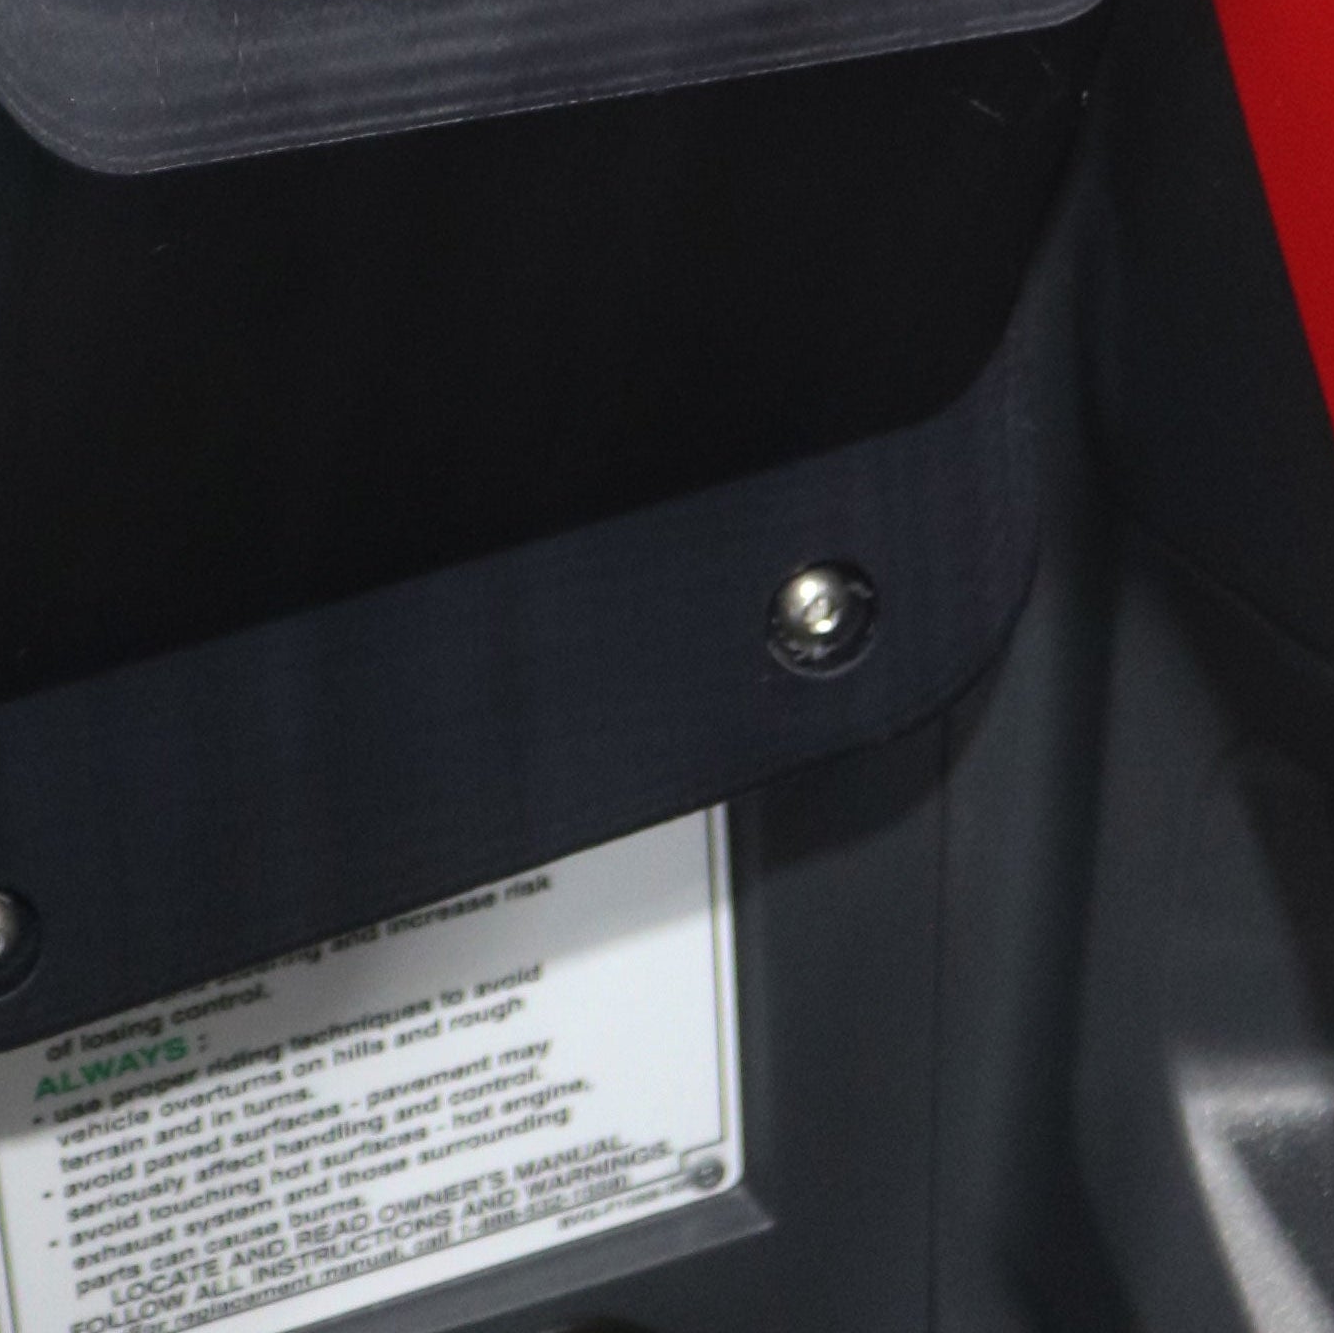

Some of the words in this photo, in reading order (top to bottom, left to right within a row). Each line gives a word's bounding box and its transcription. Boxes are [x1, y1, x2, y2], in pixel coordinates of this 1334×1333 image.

[385, 892, 497, 935] increase
[504, 876, 549, 902] risk
[34, 1036, 189, 1100] ALWAYS
[46, 1038, 73, 1061] of
[81, 1017, 162, 1050] losing
[170, 983, 269, 1024] control.
[54, 1098, 102, 1123] use
[111, 1069, 198, 1108] proper
[206, 1044, 282, 1076] riding
[289, 998, 433, 1048] techniques
[440, 988, 464, 1007] to
[472, 963, 542, 999] avoid
[57, 1110, 150, 1146] vehicle
[160, 1070, 284, 1117] overturns
[291, 1058, 325, 1078] on
[332, 1039, 385, 1067] hills
[394, 1020, 441, 1048] and
[449, 998, 524, 1031] rough
[59, 1138, 146, 1172] terrain
[155, 1116, 203, 1144] and
[211, 1111, 234, 1128] in
[243, 1087, 313, 1117] turns.
[64, 1163, 135, 1197] avoid
[144, 1136, 223, 1175] paved
[232, 1104, 341, 1145] surfaces
[367, 1057, 492, 1109] pavement
[498, 1038, 552, 1065] may
[67, 1176, 185, 1222] seriously
[195, 1150, 265, 1183] affect
[274, 1116, 385, 1158] handling
[394, 1095, 440, 1123] and
[448, 1066, 539, 1105] control.
[71, 1211, 140, 1246] avoid
[150, 1178, 262, 1221] touching
[271, 1161, 310, 1183] hot
[320, 1128, 428, 1169] surfaces
[452, 1106, 494, 1130] hot
[73, 1226, 174, 1270] exhaust
[184, 1199, 274, 1235] system
[284, 1180, 330, 1205] and
[338, 1158, 408, 1187] those
[419, 1107, 570, 1164] surrounding
[111, 1259, 219, 1305] LOCATE
[229, 1238, 286, 1268] AND
[296, 1213, 369, 1246] READ
[378, 1170, 506, 1222] OWNER'S
[70, 1291, 186, 1333] FOLLOW
[195, 1277, 243, 1302] ALL
[252, 1209, 452, 1283] INSTRUCTIONS
[463, 1190, 517, 1216] AND
[76, 1264, 141, 1297] parts
[151, 1248, 196, 1270] can
[204, 1222, 280, 1253] cause
